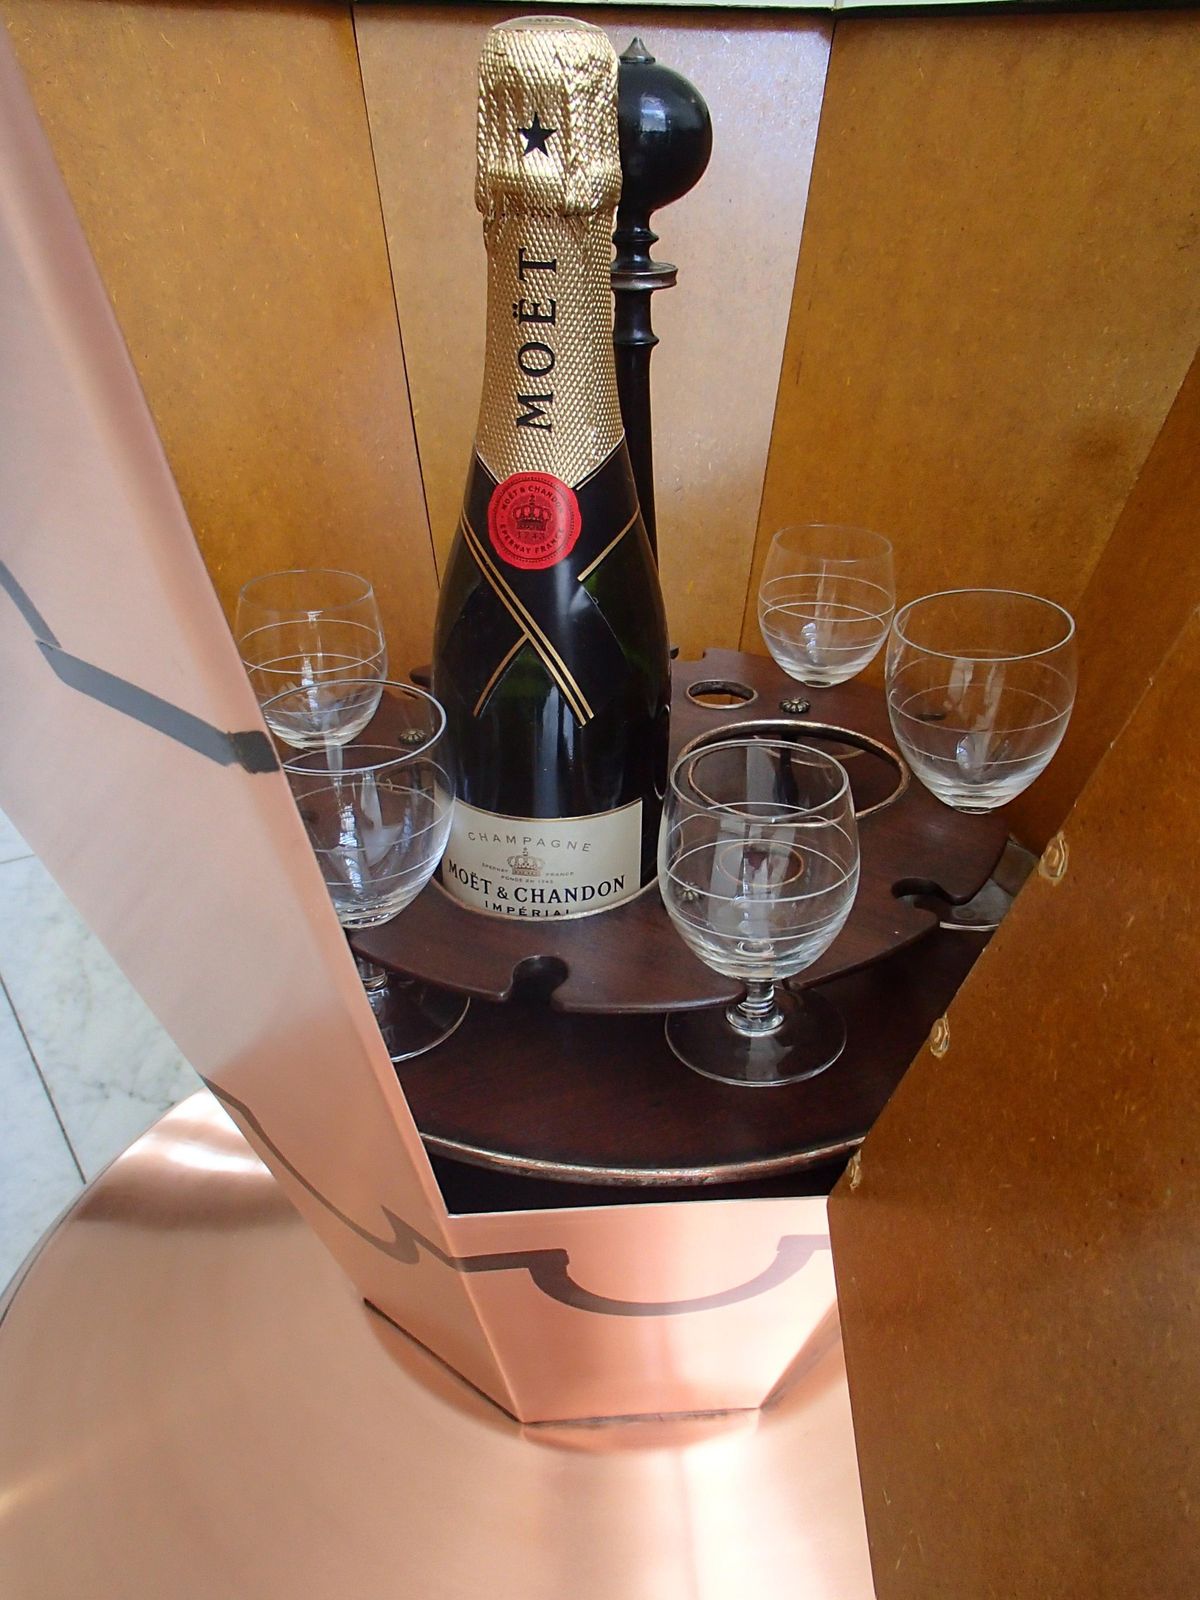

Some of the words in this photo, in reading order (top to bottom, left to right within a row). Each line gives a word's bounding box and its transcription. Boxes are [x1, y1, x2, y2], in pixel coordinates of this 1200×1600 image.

[512, 247, 557, 433] MOËT
[467, 831, 592, 853] CHAMPAGNE
[448, 858, 492, 895] MOËT
[496, 886, 509, 900] &
[513, 875, 626, 904] CHANDON
